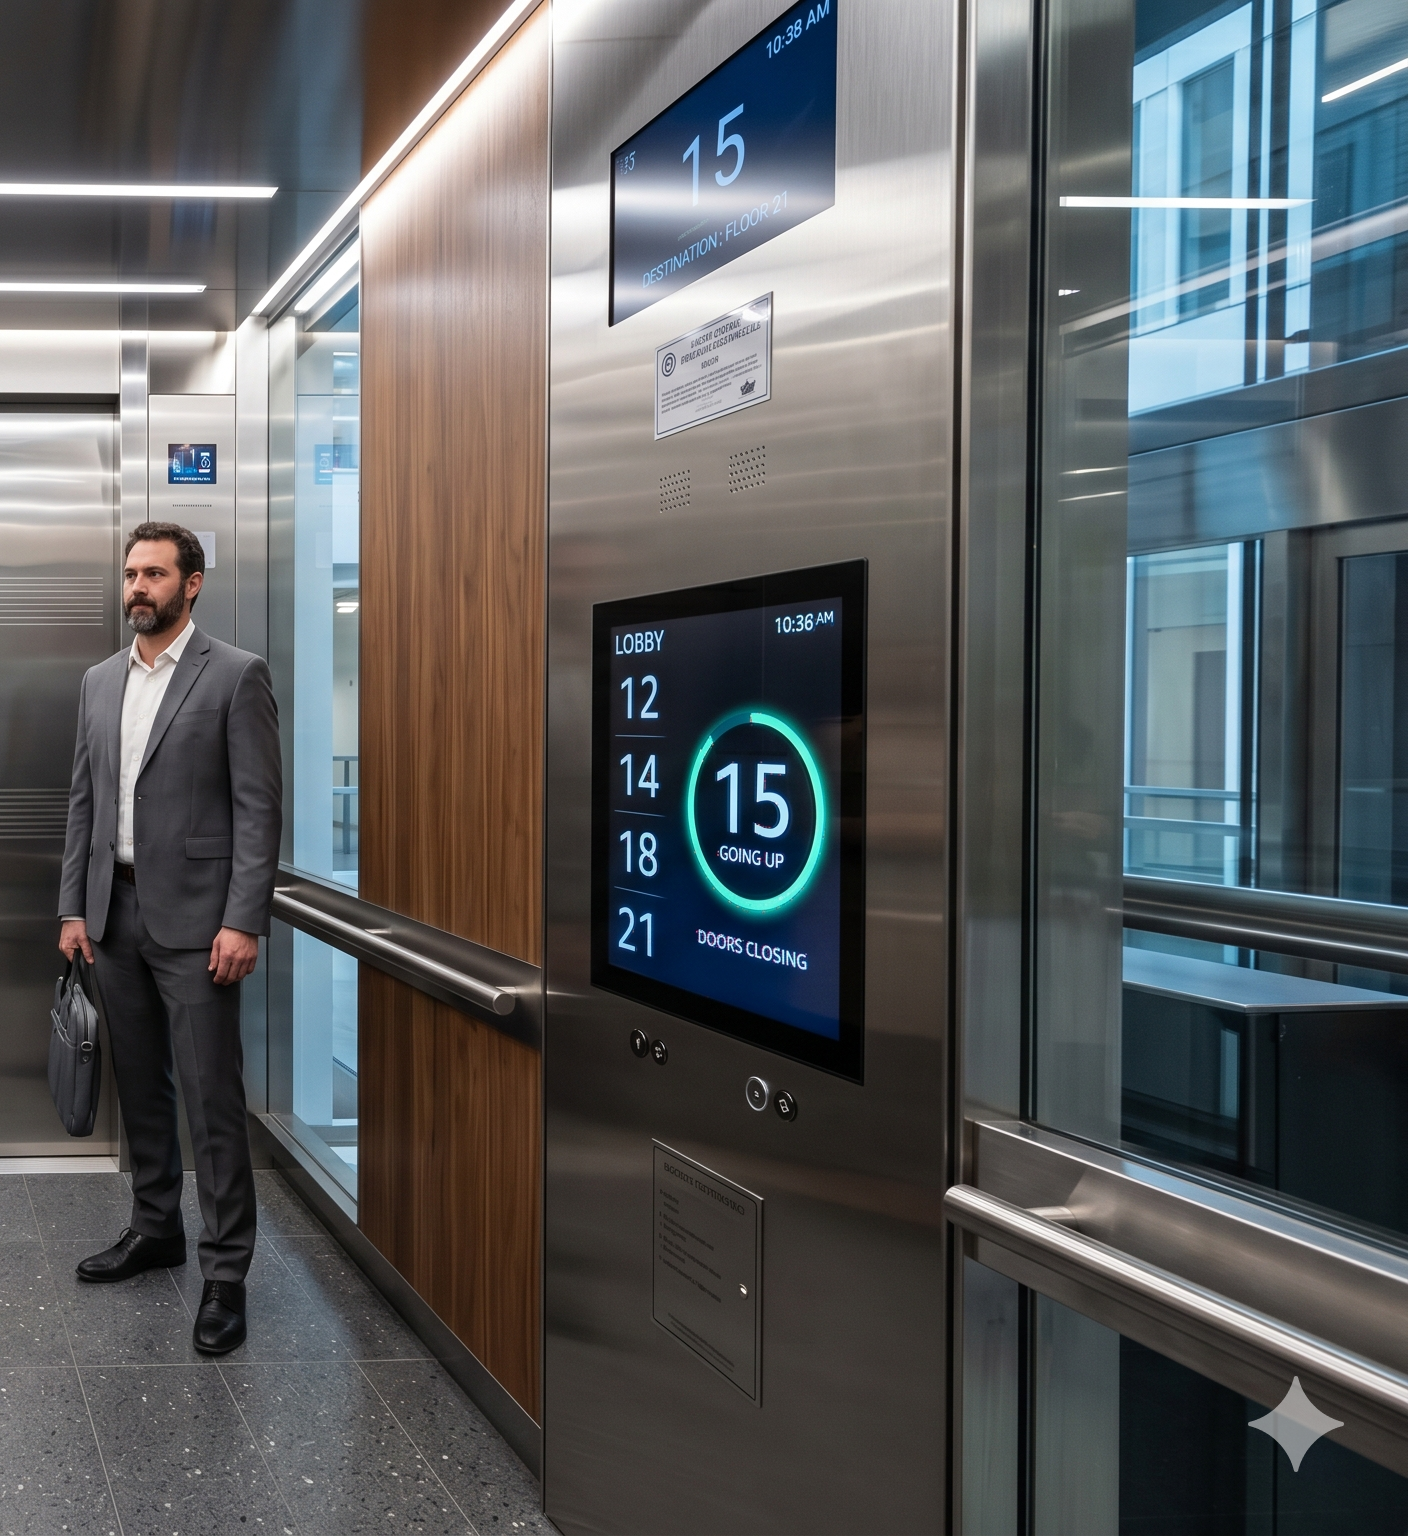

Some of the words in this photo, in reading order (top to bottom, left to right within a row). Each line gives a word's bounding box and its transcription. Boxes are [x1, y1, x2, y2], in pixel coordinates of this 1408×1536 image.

[766, 18, 803, 59] 10:38
[805, 0, 830, 31] AM
[681, 102, 746, 208] 15
[725, 202, 769, 242] FLOOR
[772, 190, 788, 215] 21
[615, 629, 665, 655] LOBBY
[775, 613, 814, 634] 10:36
[815, 610, 834, 626] AM
[620, 674, 660, 720] 12
[619, 752, 660, 798] 14
[716, 762, 790, 839] 15
[619, 830, 659, 878] 18
[719, 845, 762, 866] GOING
[764, 851, 785, 869] UP
[618, 906, 653, 958] 21
[697, 928, 743, 954] DOORS
[745, 940, 808, 971] CLOSING
